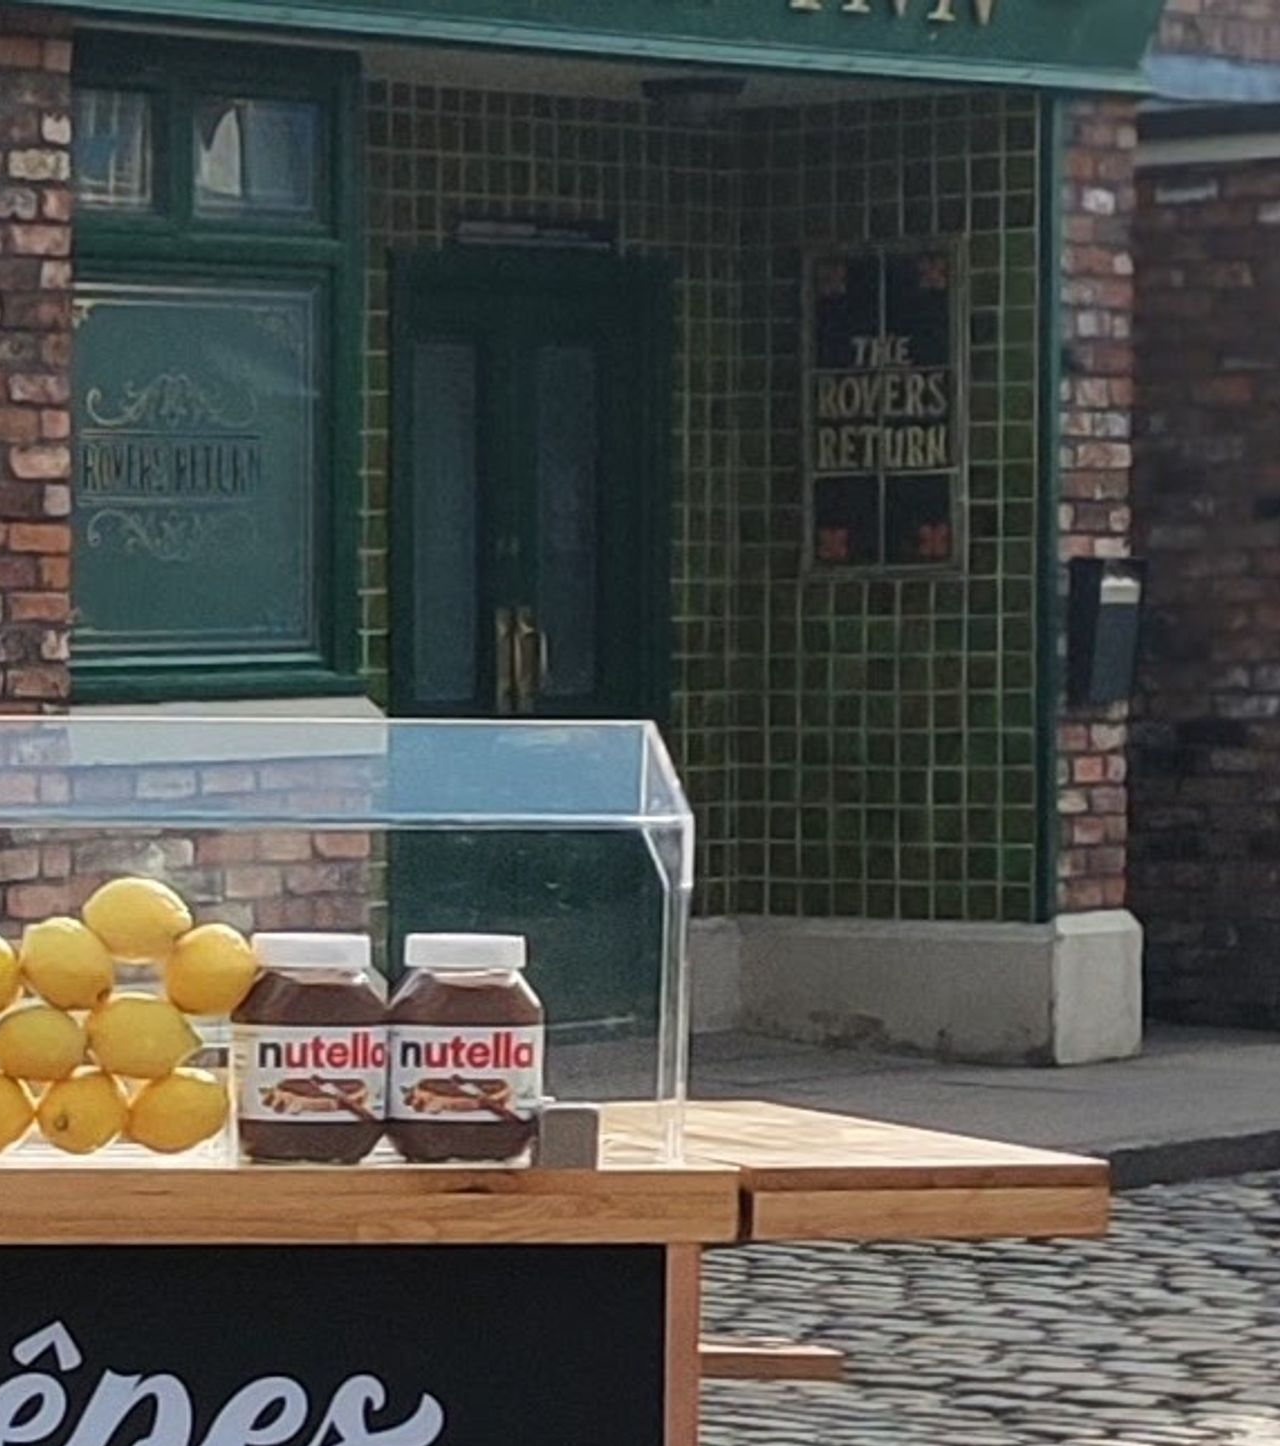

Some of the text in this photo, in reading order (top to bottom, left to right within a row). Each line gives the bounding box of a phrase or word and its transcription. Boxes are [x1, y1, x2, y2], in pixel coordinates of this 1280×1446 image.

[850, 337, 912, 365] THE
[816, 373, 947, 419] ROVERS
[817, 427, 947, 469] RETURN
[399, 1031, 535, 1070] nutella
